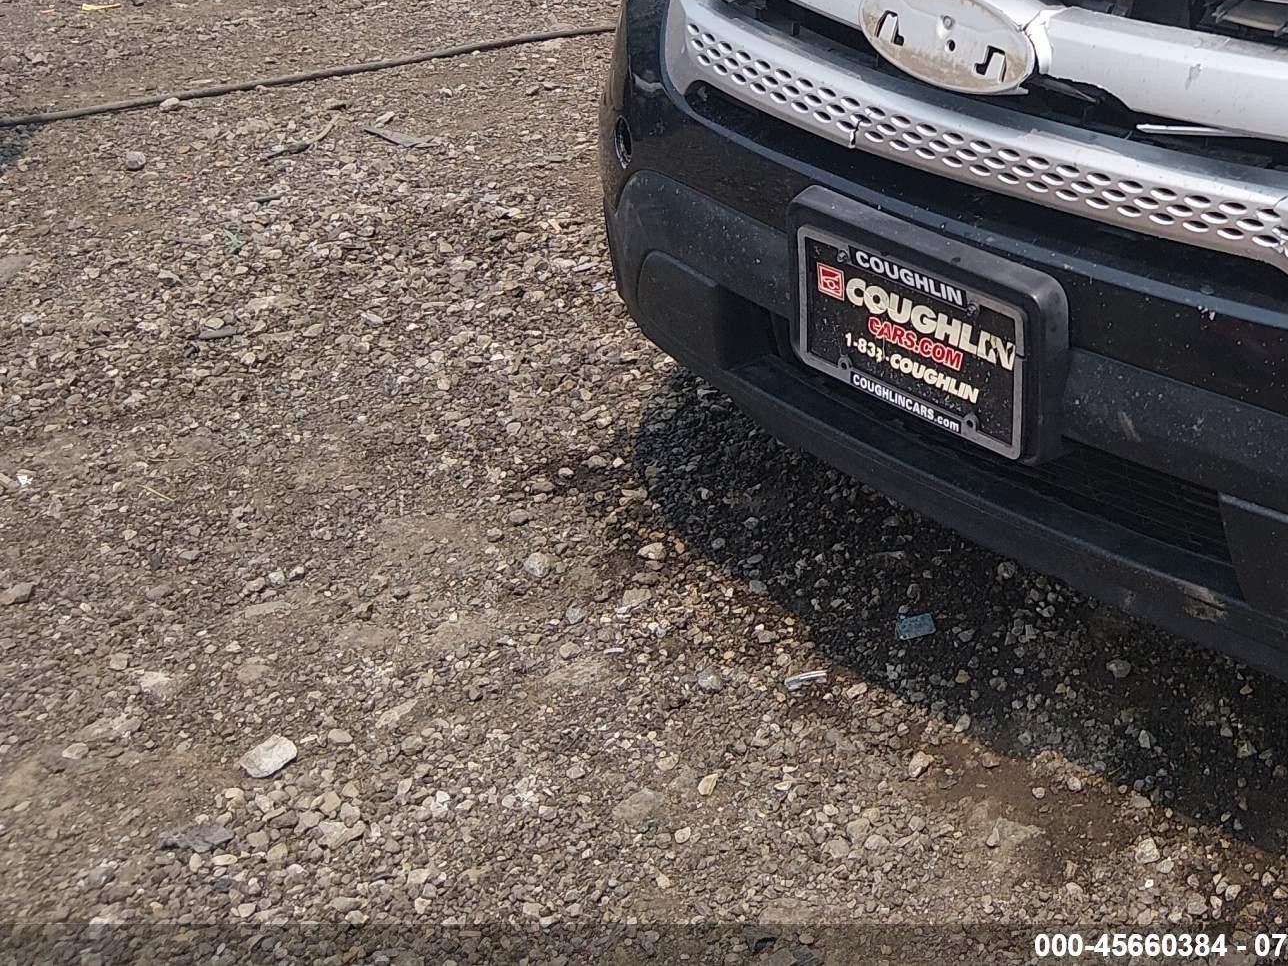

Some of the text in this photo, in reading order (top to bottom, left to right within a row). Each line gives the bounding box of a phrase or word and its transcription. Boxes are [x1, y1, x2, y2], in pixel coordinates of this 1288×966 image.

[855, 251, 962, 305] COUGHLIN
[846, 278, 1015, 371] COUGHLIN
[868, 317, 963, 370] CARS.COM
[853, 374, 960, 432] COUGHLINCARS.com
